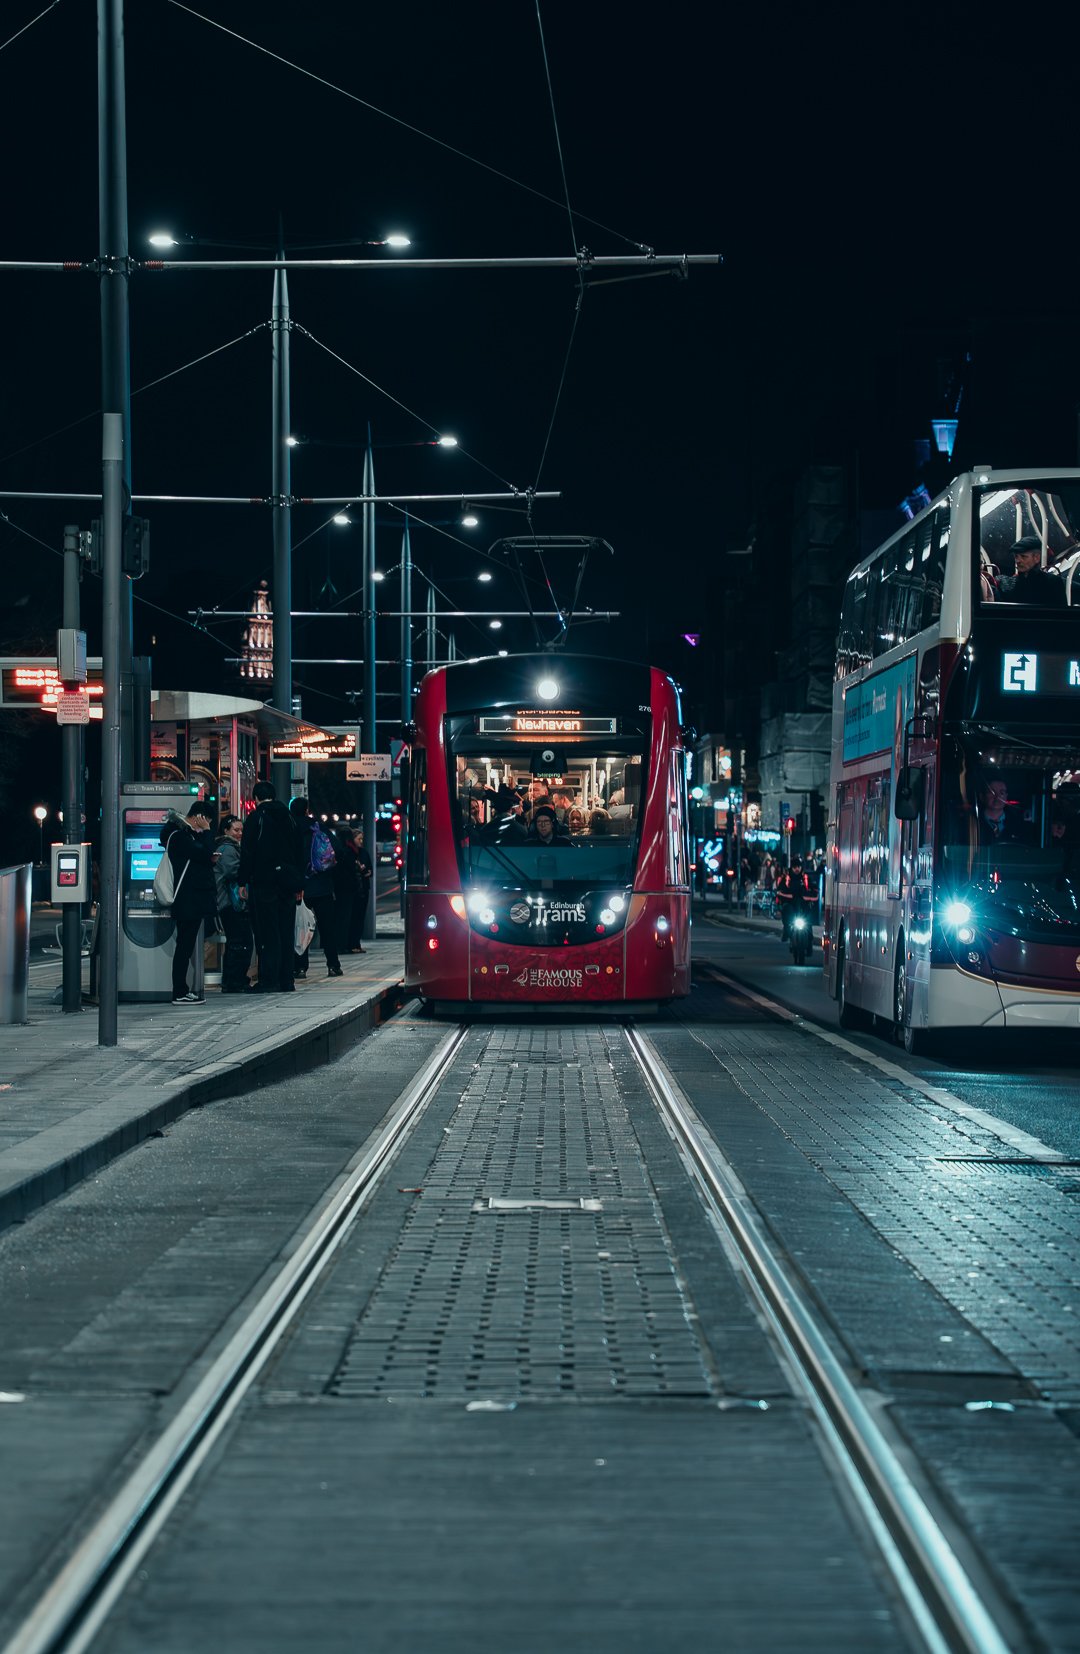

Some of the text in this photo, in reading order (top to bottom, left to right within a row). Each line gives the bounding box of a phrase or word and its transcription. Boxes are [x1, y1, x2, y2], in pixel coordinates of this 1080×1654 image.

[517, 718, 580, 730] Newhaven
[550, 902, 585, 911] Edinburgh
[533, 905, 586, 922] Trams
[530, 968, 538, 986] THE
[538, 968, 582, 979] FAMOUS
[537, 978, 582, 988] GROUSE
